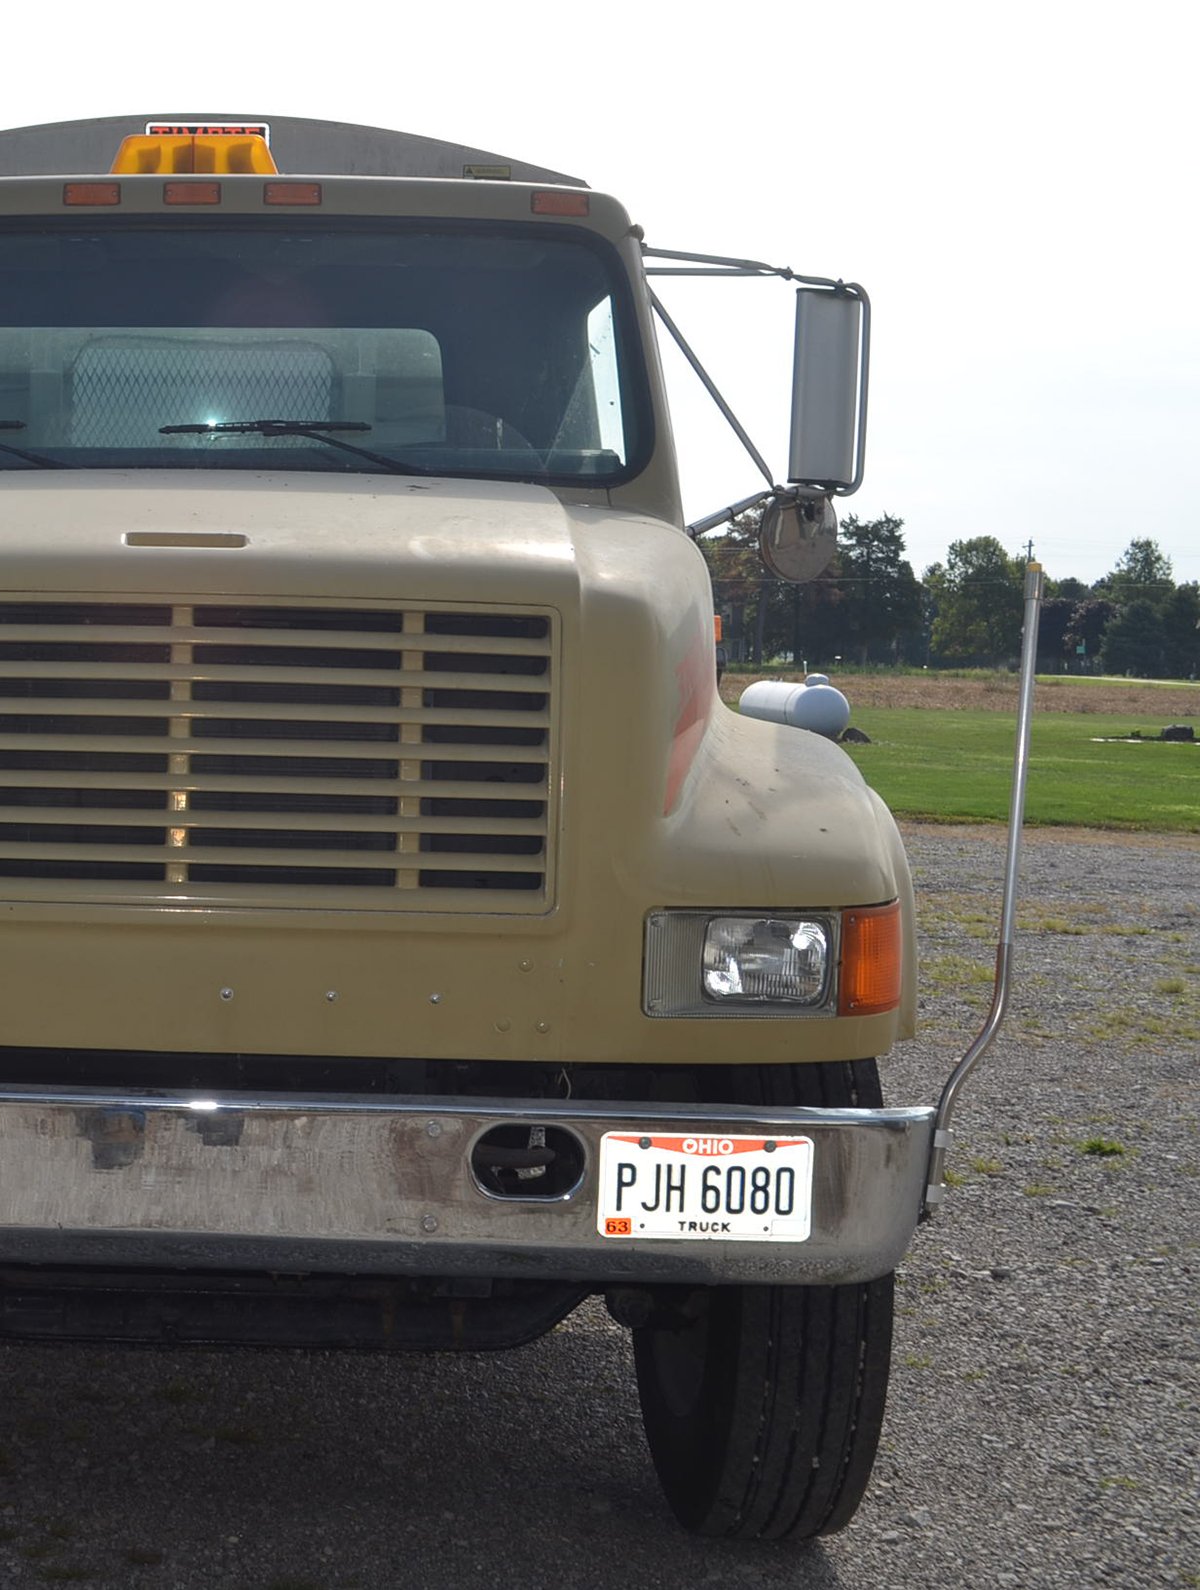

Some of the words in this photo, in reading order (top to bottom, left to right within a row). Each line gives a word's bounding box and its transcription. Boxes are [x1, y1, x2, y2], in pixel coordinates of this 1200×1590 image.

[682, 1138, 734, 1155] OHIO
[701, 1165, 795, 1215] 6080
[606, 1221, 629, 1233] 63
[678, 1221, 731, 1233] TRUCK
